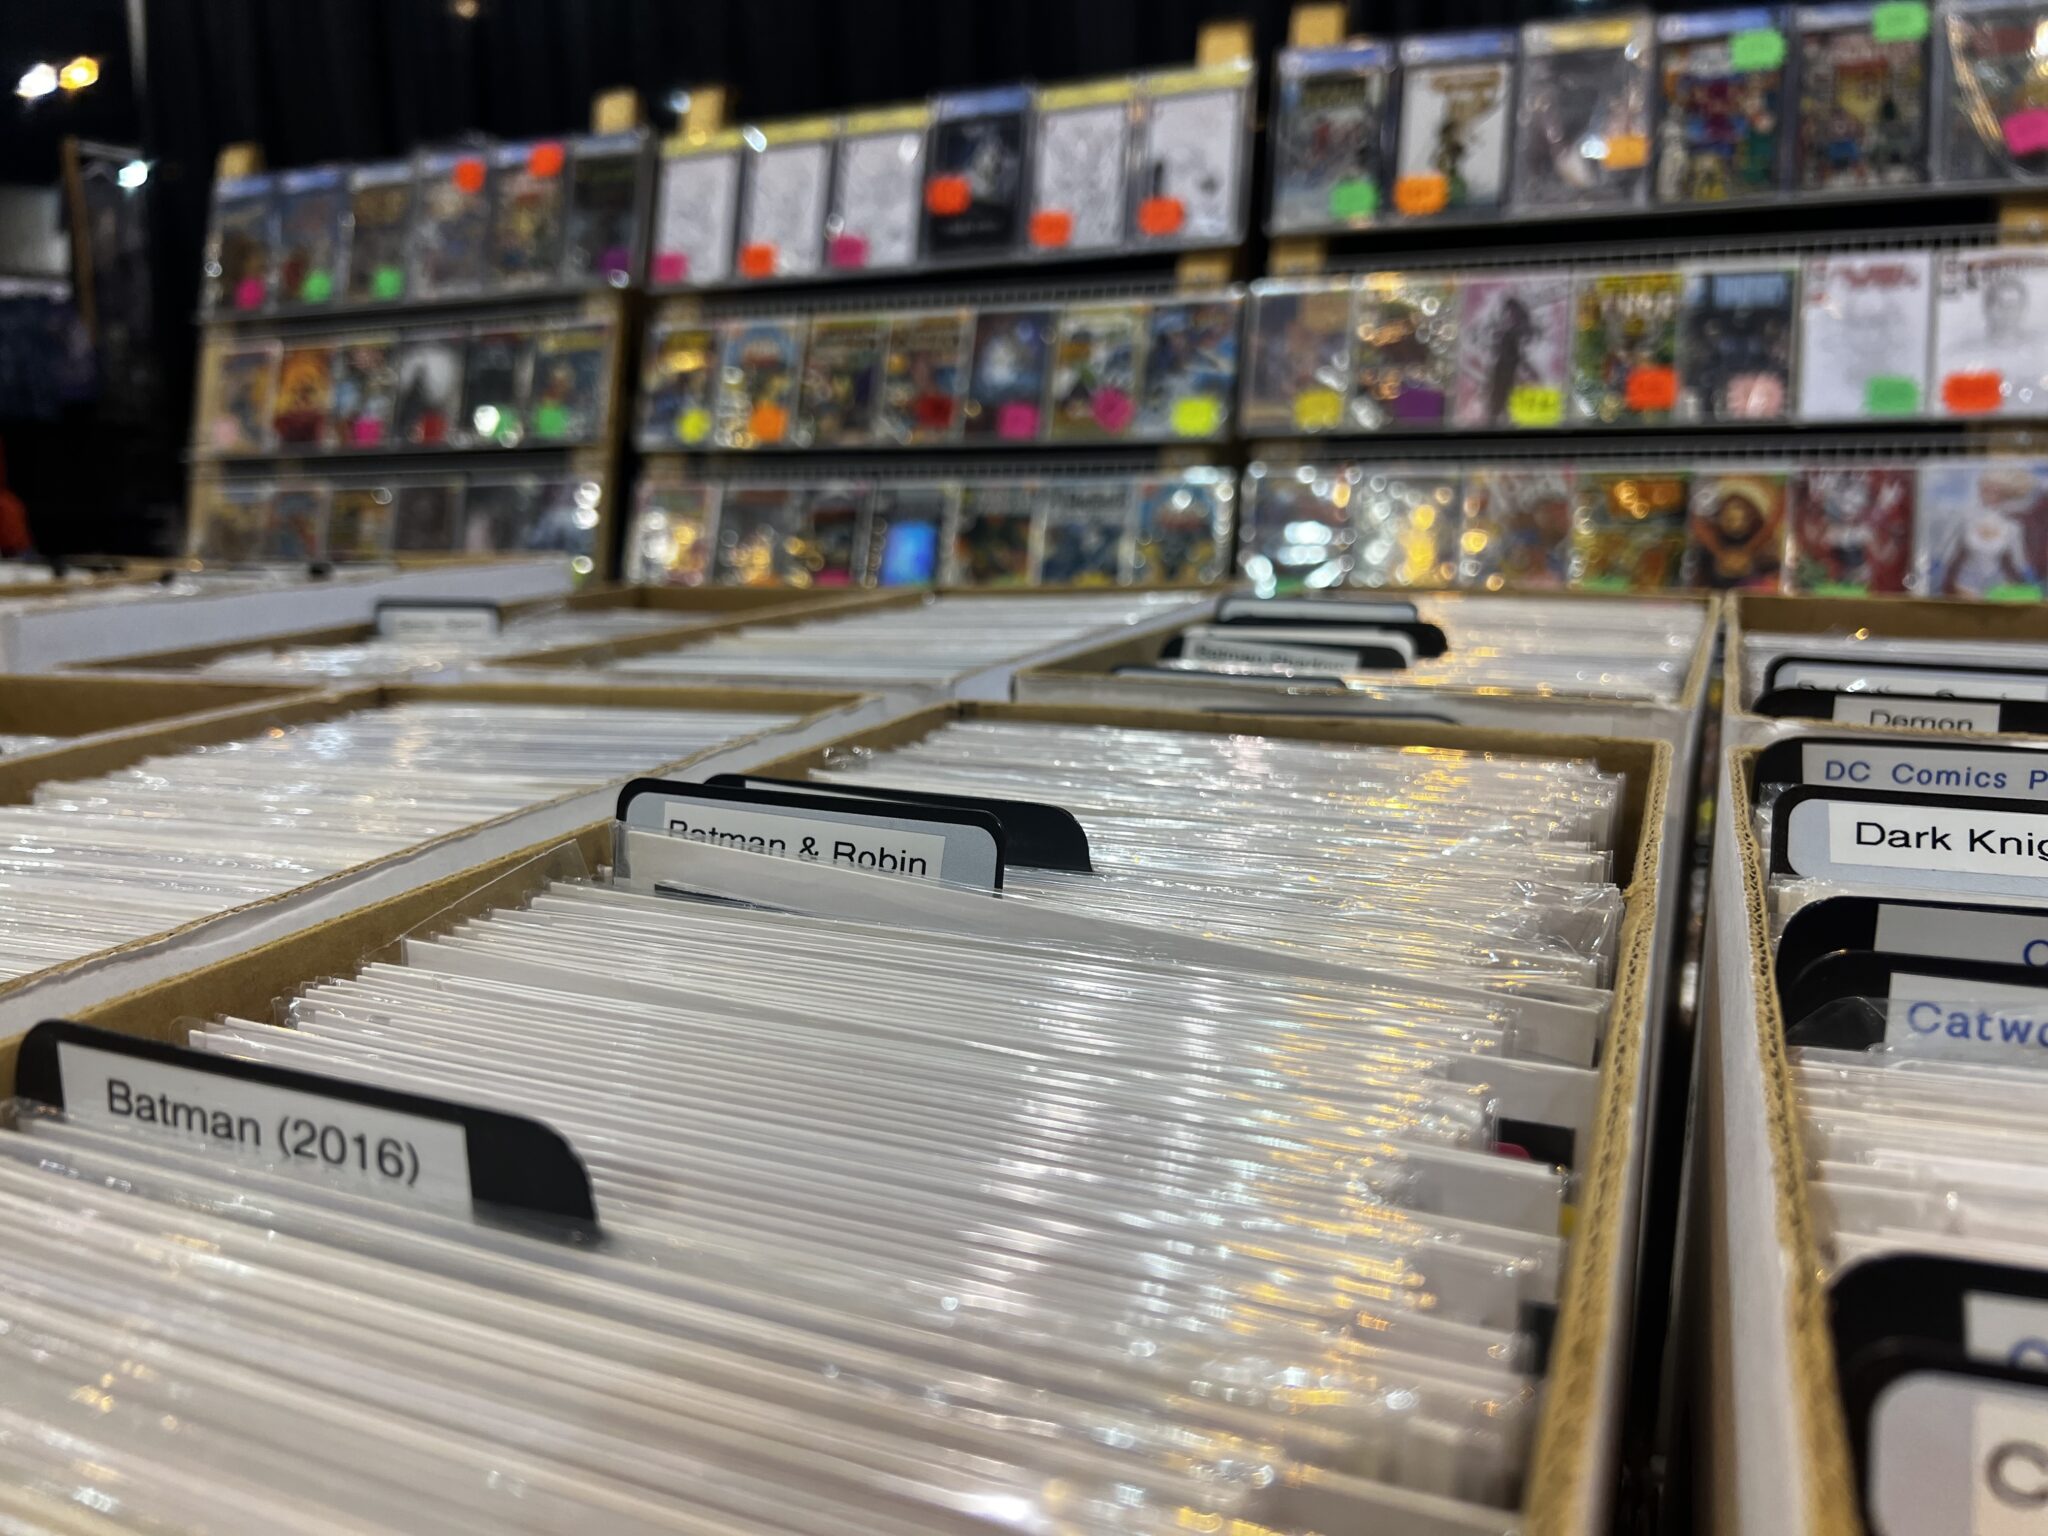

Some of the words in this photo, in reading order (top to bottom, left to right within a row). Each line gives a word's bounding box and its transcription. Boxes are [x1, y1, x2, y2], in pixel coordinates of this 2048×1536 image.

[1869, 709, 1973, 731] Demon
[1824, 760, 1871, 782] DC
[1891, 763, 2008, 789] Comics
[1855, 821, 1953, 851] Dark
[799, 836, 820, 858] &
[833, 840, 927, 876] Robin
[106, 1077, 261, 1147] Batman
[277, 1115, 420, 1187] (2016)
